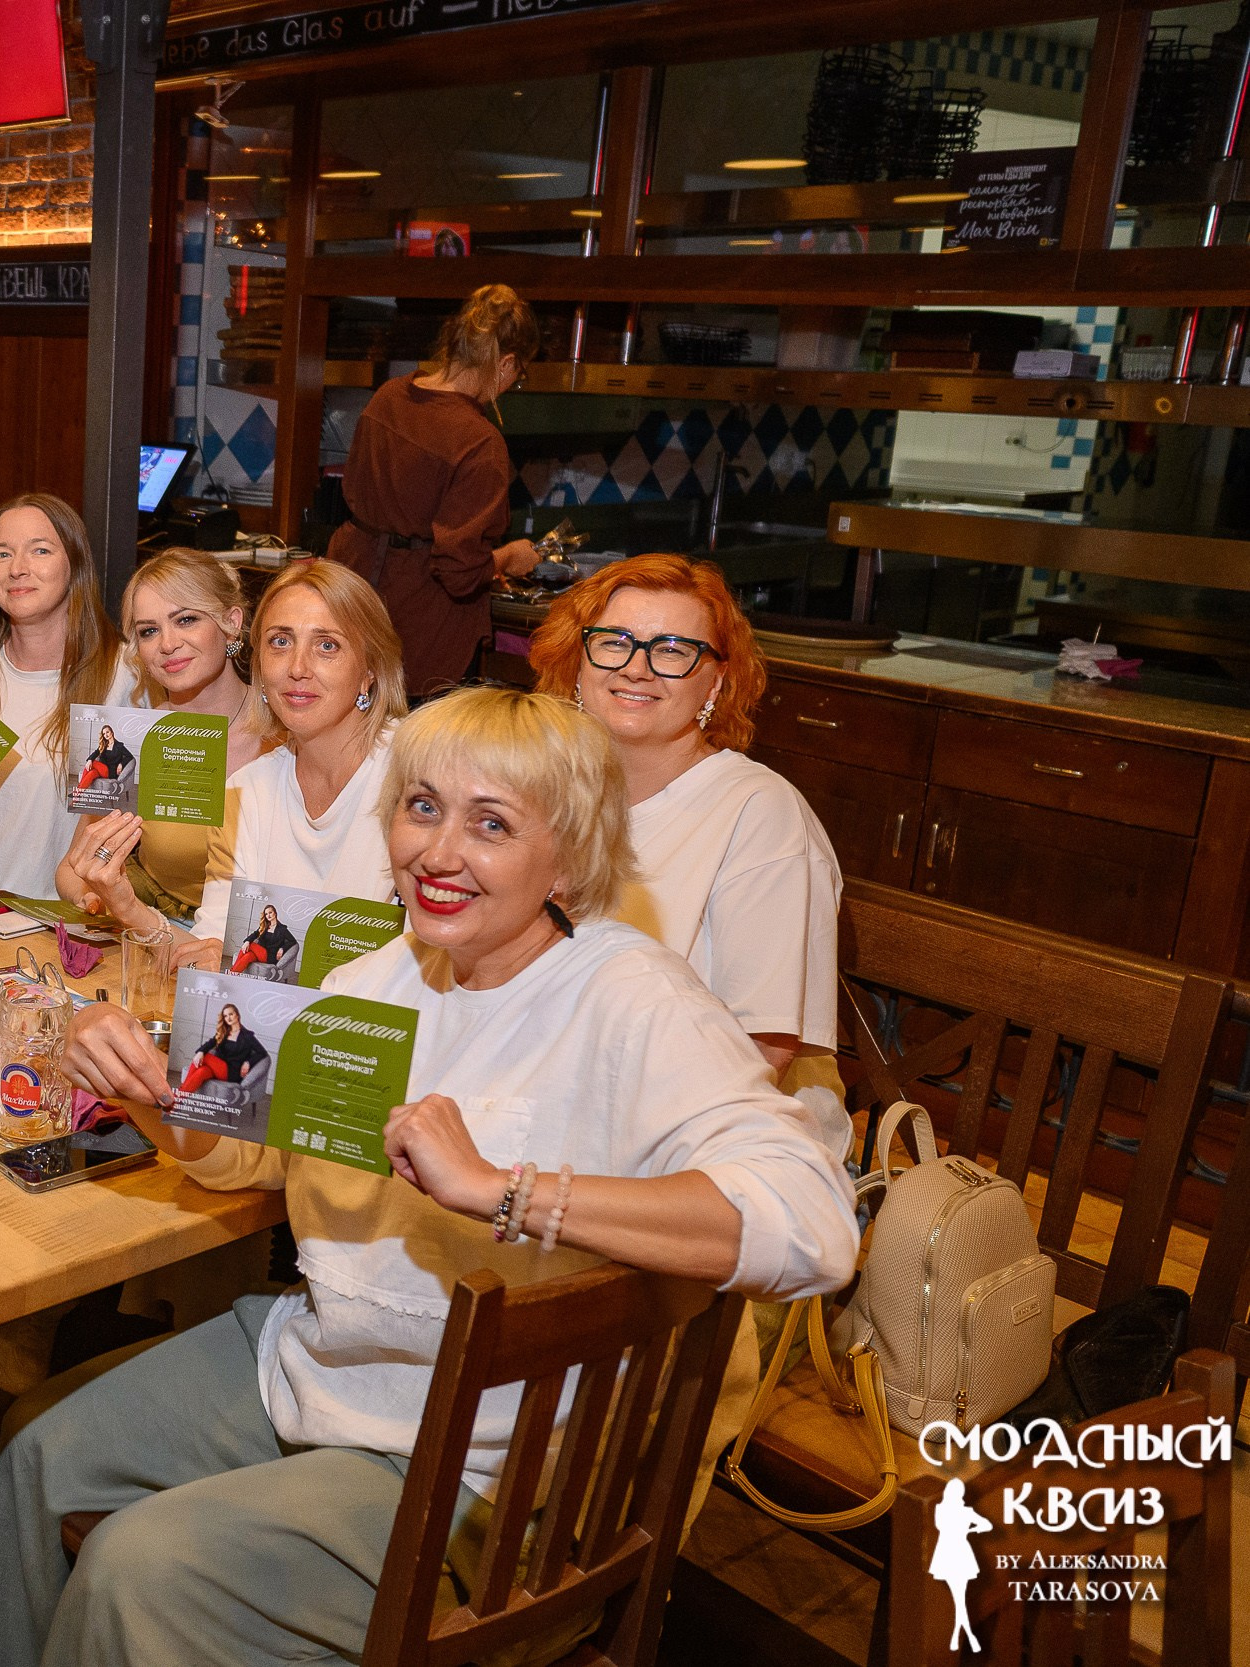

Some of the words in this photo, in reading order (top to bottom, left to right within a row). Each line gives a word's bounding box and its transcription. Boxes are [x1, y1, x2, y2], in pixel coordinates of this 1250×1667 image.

[226, 28, 268, 56] das
[283, 16, 343, 47] Glas
[969, 183, 1041, 200] команды
[987, 205, 1056, 221] пивоварни
[955, 221, 992, 239] Max
[996, 221, 1040, 239] Bräu
[329, 933, 377, 949] Подарочный
[312, 1044, 378, 1066] Подарочный
[312, 1054, 375, 1075] Сертификат
